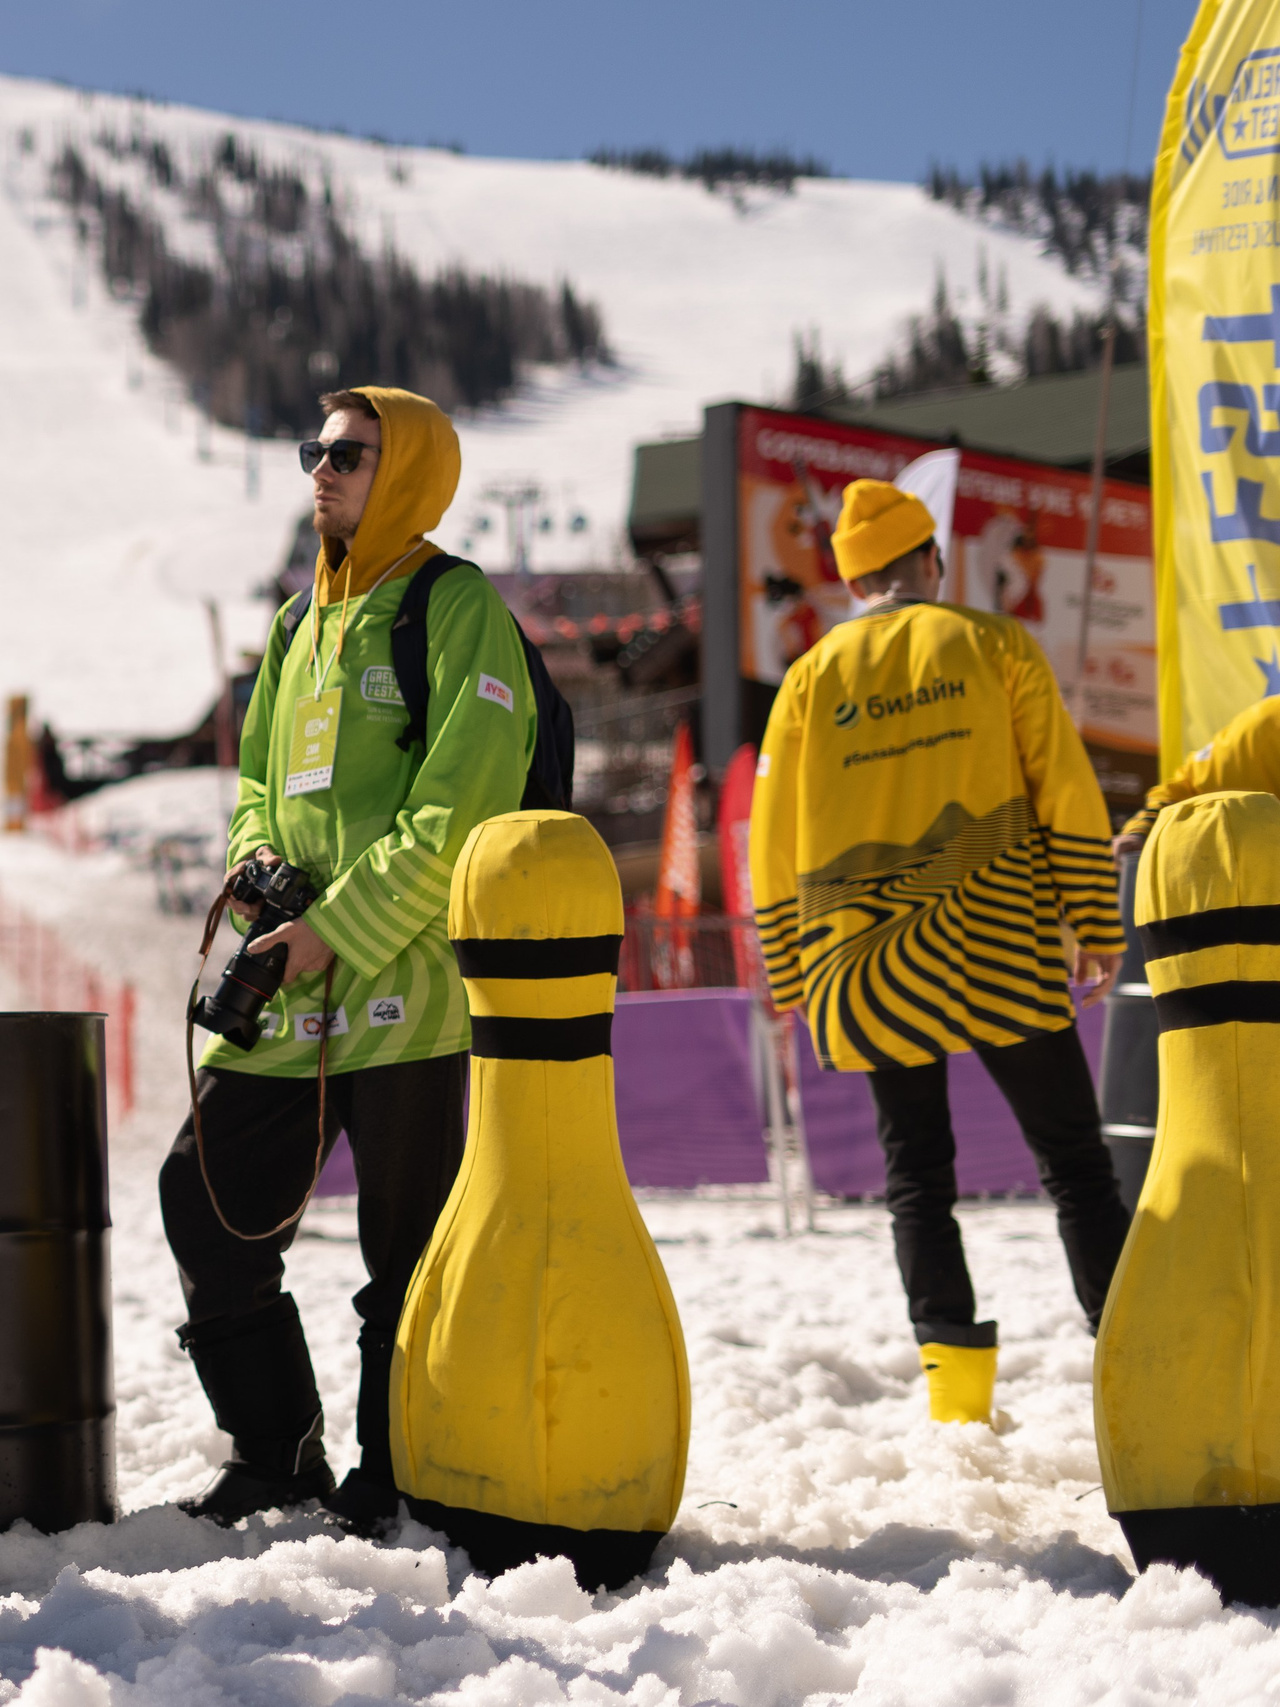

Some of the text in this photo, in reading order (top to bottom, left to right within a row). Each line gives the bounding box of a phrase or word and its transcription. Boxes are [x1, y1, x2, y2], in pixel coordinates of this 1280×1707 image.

[369, 671, 399, 685] GREL
[368, 684, 395, 698] FEST
[866, 677, 966, 720] билайн
